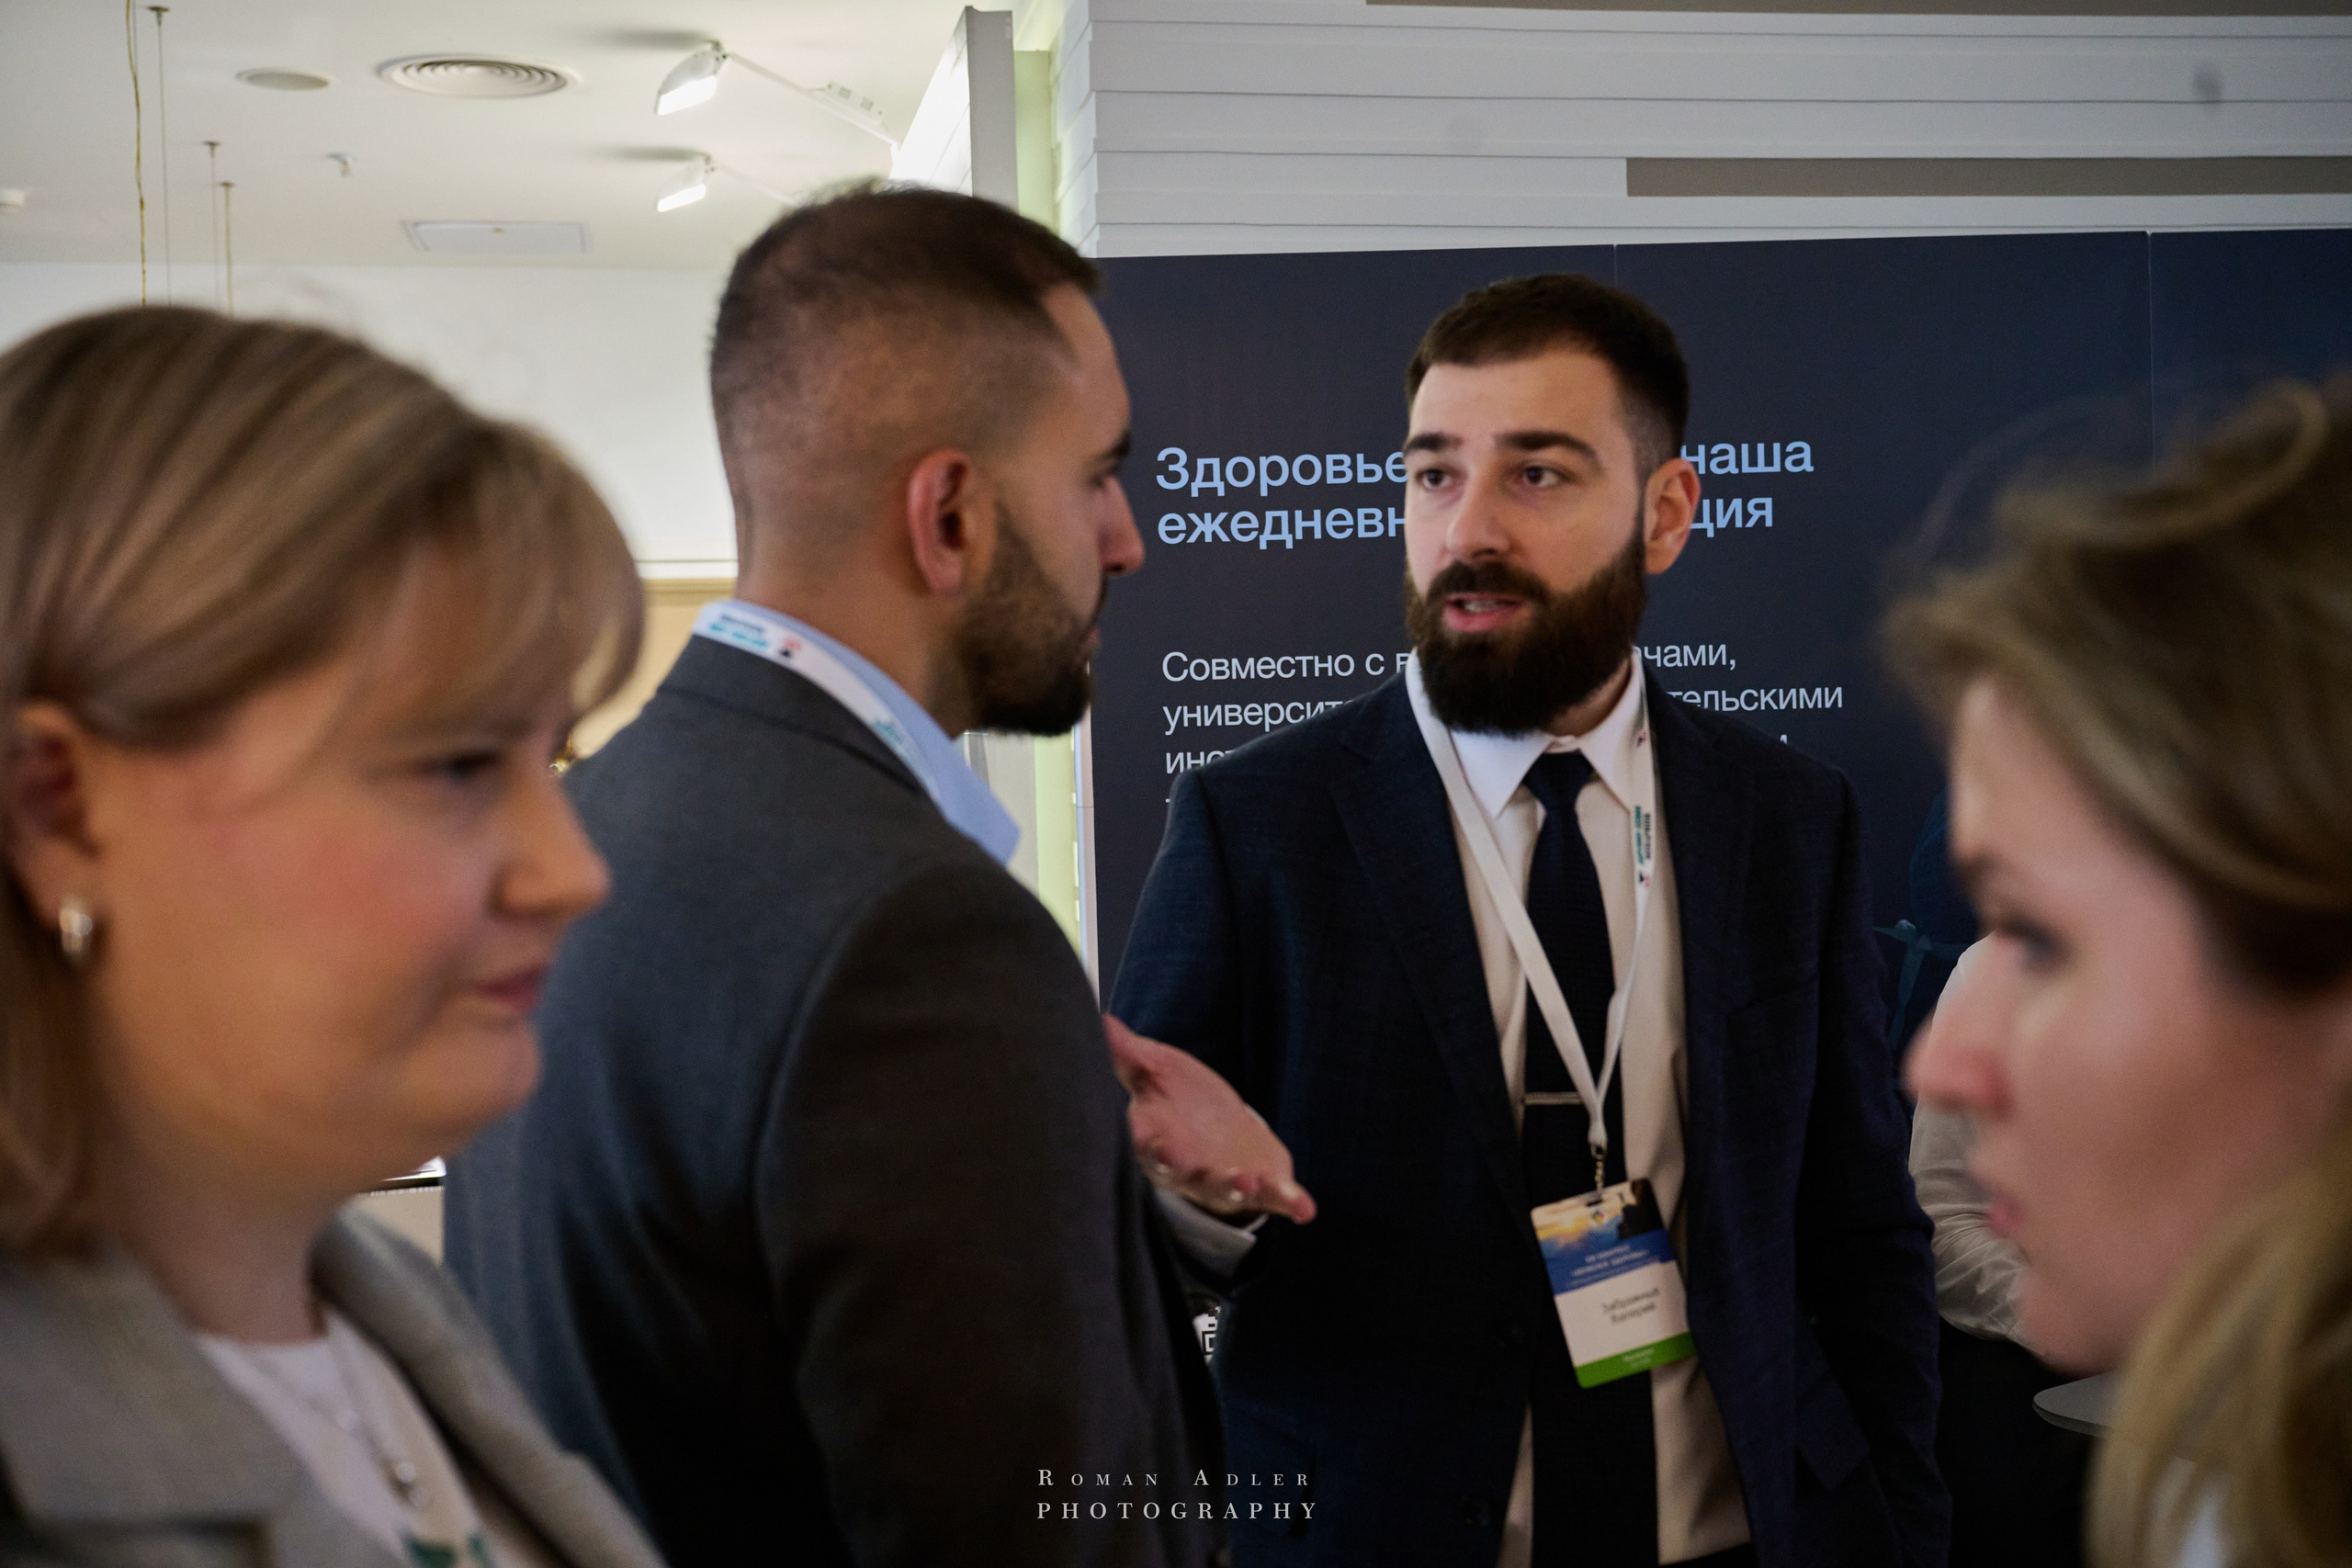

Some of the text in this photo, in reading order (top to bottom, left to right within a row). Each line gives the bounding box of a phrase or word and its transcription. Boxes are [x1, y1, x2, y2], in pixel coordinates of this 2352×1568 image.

[1156, 441, 1815, 497] Здоровье наша
[1158, 497, 1773, 549] ежедневн ция
[1161, 651, 1355, 682] Совместно
[1365, 653, 1385, 676] с
[1634, 644, 1736, 671] чами,
[1161, 686, 1843, 736] университ ельскими
